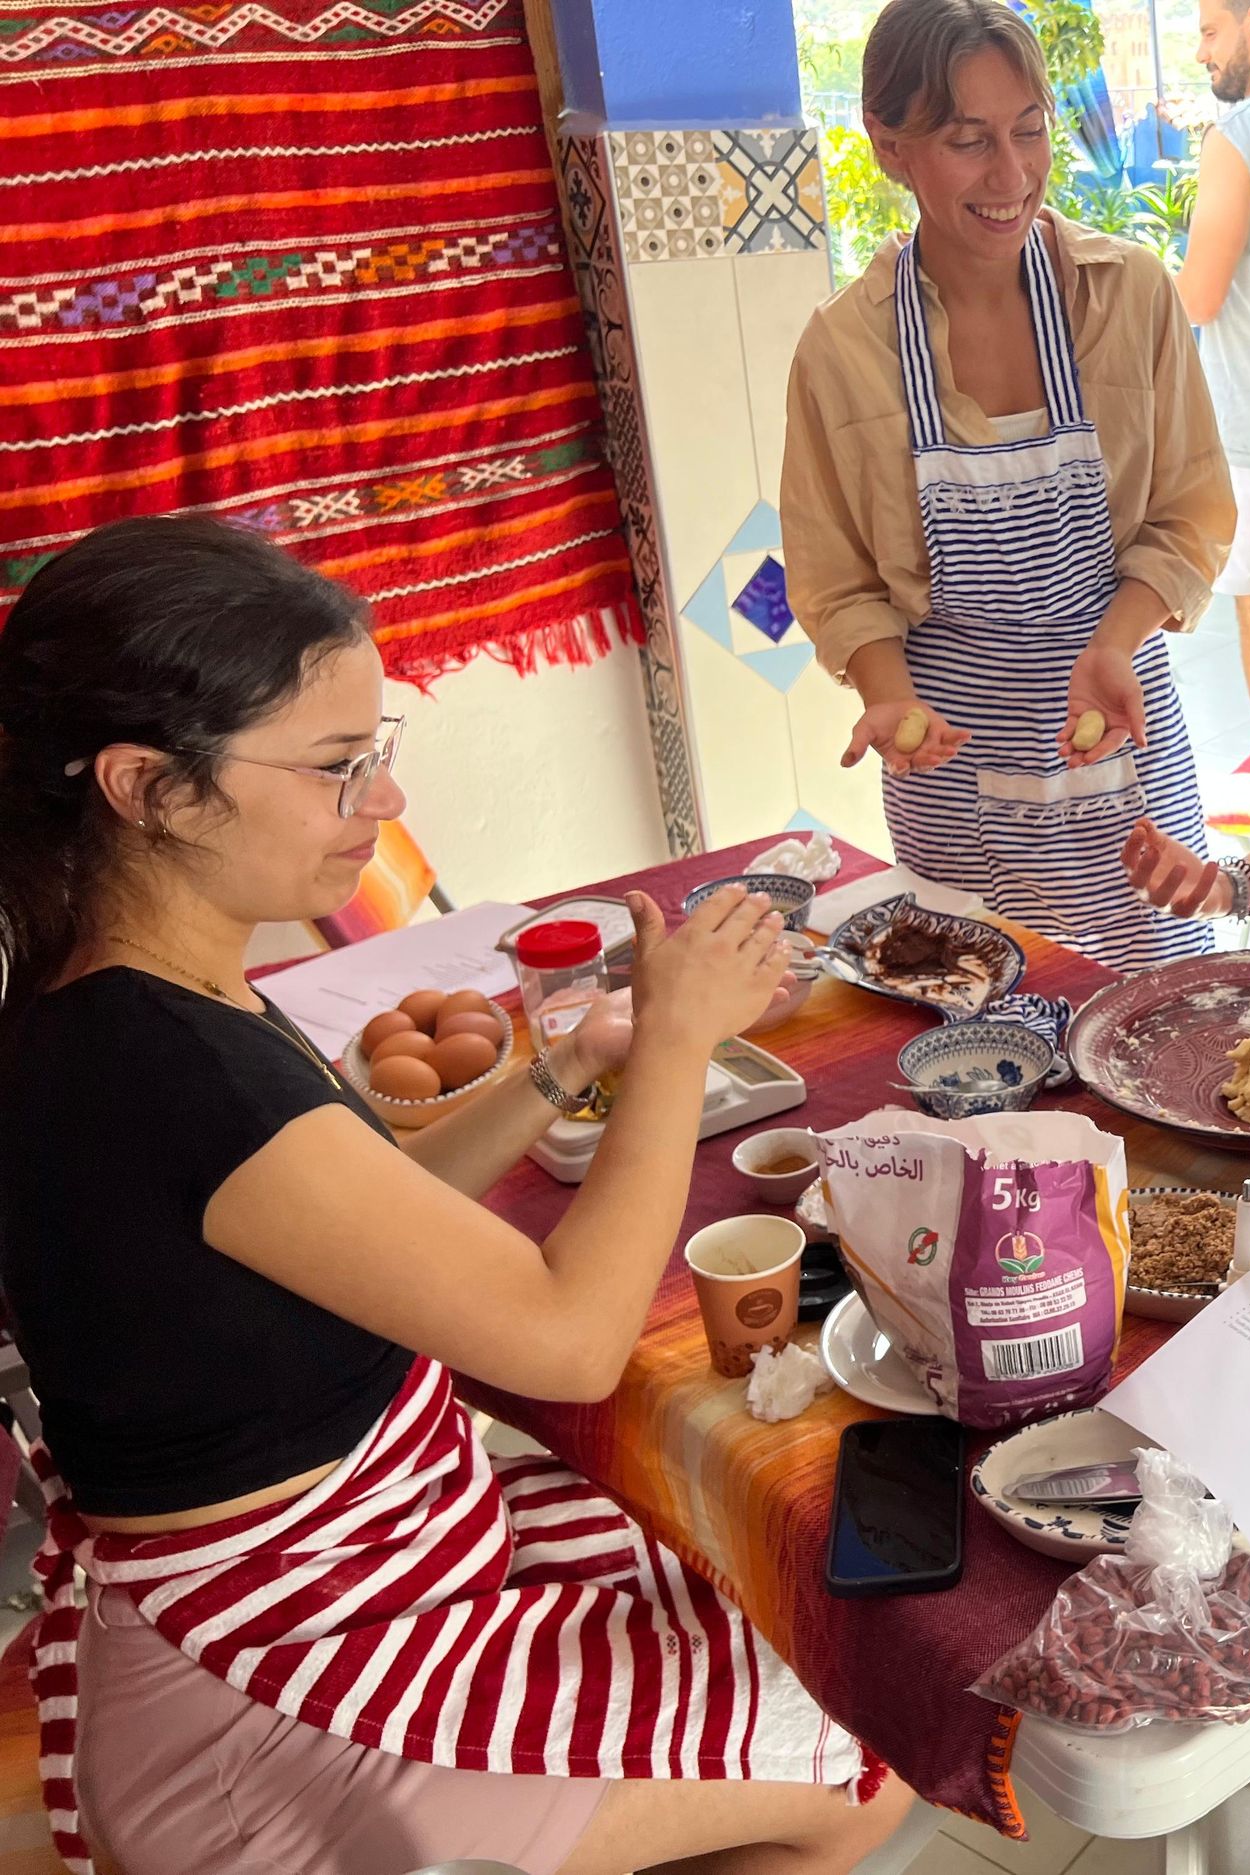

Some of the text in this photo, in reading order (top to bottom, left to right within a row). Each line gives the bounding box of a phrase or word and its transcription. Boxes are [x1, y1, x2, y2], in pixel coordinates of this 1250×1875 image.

[866, 1156, 922, 1181] الخاص
[979, 1287, 1004, 1296] GRANDS
[1006, 1284, 1034, 1296] MOULINS
